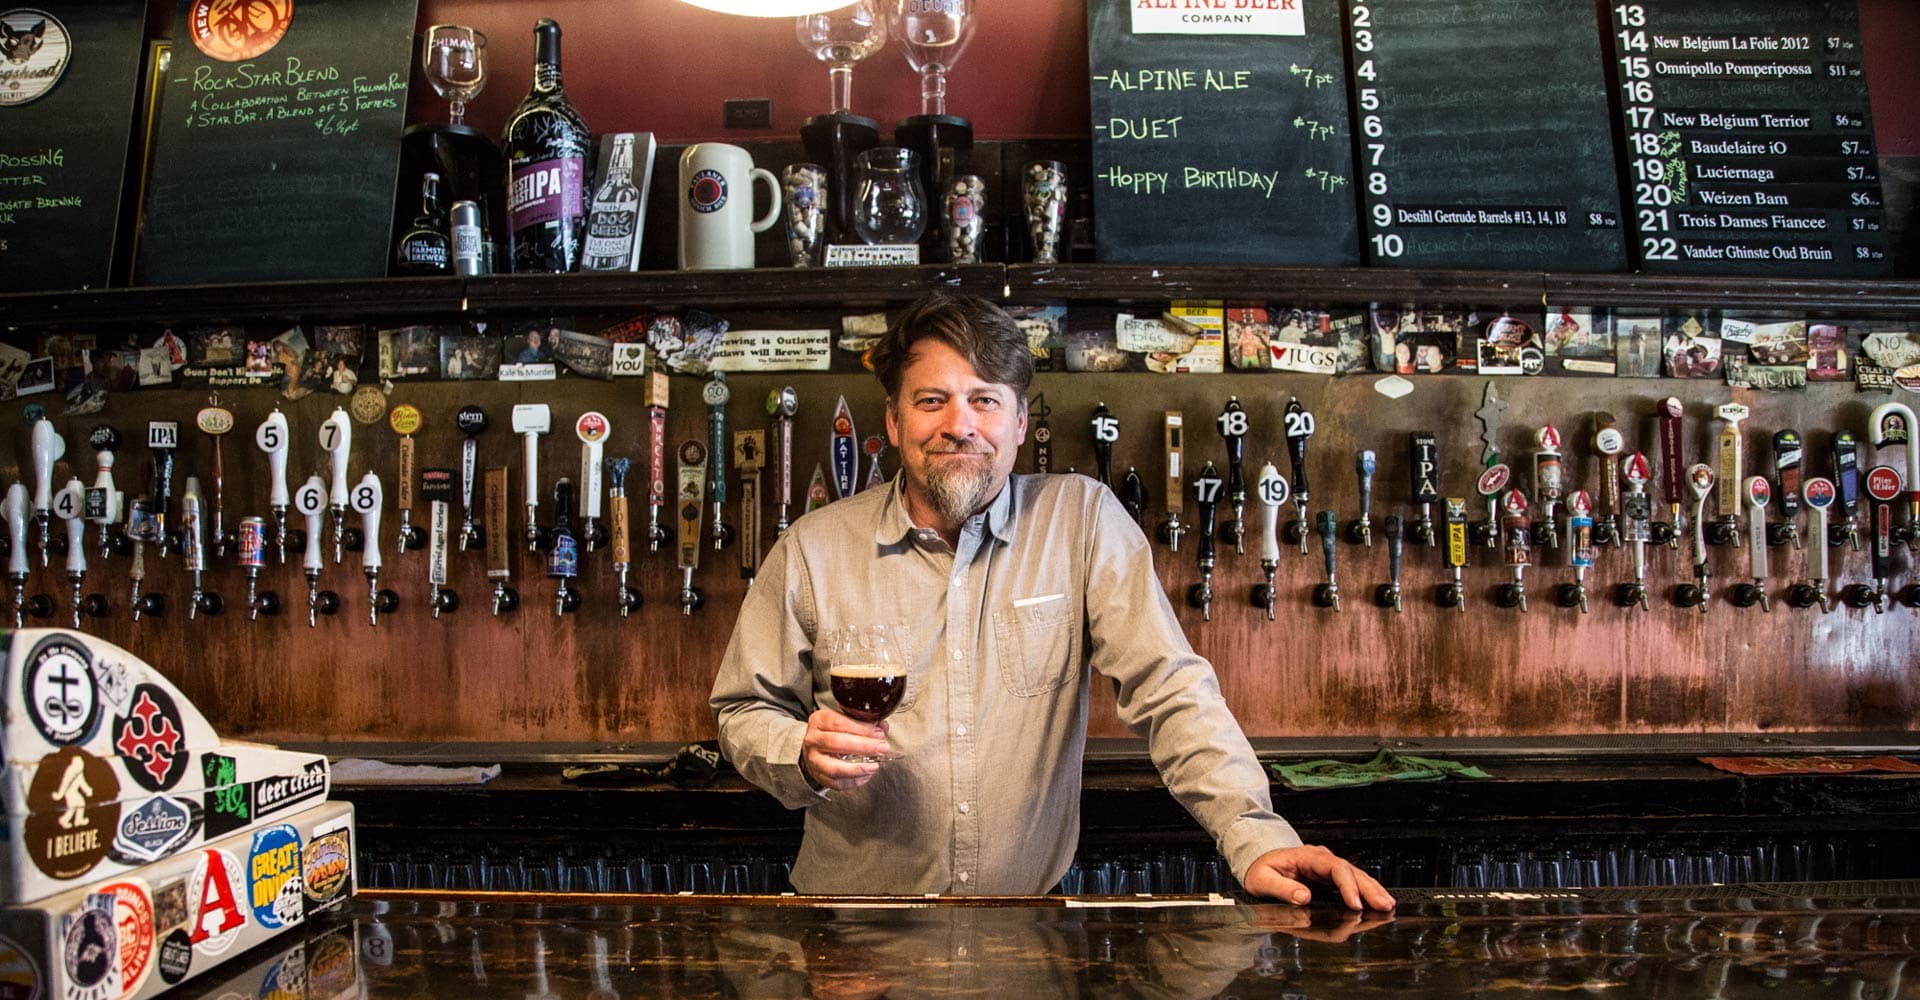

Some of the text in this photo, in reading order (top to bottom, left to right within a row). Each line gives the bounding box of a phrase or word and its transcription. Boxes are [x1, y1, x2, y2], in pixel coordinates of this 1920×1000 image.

[197, 4, 211, 38] NEW
[1182, 15, 1253, 23] COMPANY
[1352, 6, 1371, 27] 2
[1615, 5, 1646, 26] 13
[431, 37, 475, 50] CHIMAY
[1355, 31, 1374, 51] 3
[1618, 30, 1840, 53] 14 New Belgium La Folie 2012 $7
[285, 57, 339, 86] BLEND
[1357, 60, 1376, 81] 4
[1620, 56, 1846, 78] 15 Omnipollo Pomperipossa $11
[1204, 69, 1251, 91] ALE
[202, 94, 287, 111] COLLABORATION
[297, 87, 349, 102] BETWEEN
[1360, 89, 1379, 110] 5
[1623, 81, 1654, 103] 16
[198, 112, 231, 127] STAR
[266, 108, 273, 120] A
[278, 106, 314, 120] BLEND
[319, 103, 335, 113] OF
[339, 99, 349, 112] 5
[1626, 107, 1848, 130] 17 New Belgium Terrior $6
[1363, 116, 1383, 137] 6
[1367, 144, 1385, 166] 7
[1630, 133, 1661, 155] 18
[1691, 140, 1765, 154] Baudelaire
[1841, 141, 1858, 154] $7
[1633, 159, 1864, 181] 19 Luciernaga $7
[529, 168, 561, 202] IPA
[1369, 173, 1387, 195] 8
[36, 195, 82, 209] BREWING
[1636, 184, 1870, 207] 20 Weizen Bam $6
[597, 212, 629, 225] DOS
[1373, 204, 1602, 227] 9 Destihl Gertrude Barrels #13, 14, 18 $8
[1639, 209, 1864, 231] 21 Trois Dames Fiancee $7
[591, 223, 630, 237] BEERS
[1371, 234, 1404, 257] 10
[1642, 238, 1869, 260] 22 Vander Ghinste Oud Bruin $8
[1186, 308, 1208, 316] BEER
[720, 336, 828, 346] rewing is Outlawed
[1876, 335, 1901, 351] NO
[712, 347, 828, 358] utlaws will Brew Beer
[1287, 350, 1336, 368] JUGS
[184, 367, 233, 376] Guns Don't
[500, 367, 554, 377] Kale Murder
[615, 361, 641, 371] YOU
[1860, 374, 1893, 386] BEER
[459, 411, 483, 422] stem
[1218, 411, 1248, 436] 18
[1285, 412, 1314, 437] 20
[151, 428, 176, 443] IPA
[264, 426, 278, 448] 5
[325, 425, 337, 447] 7
[1091, 416, 1120, 442] 15
[653, 424, 663, 478] WHEAT
[839, 437, 849, 490] FAT TIRE
[1419, 445, 1437, 495] IPA
[303, 488, 318, 510] 6
[358, 487, 374, 509] 8
[1195, 478, 1222, 502] 17
[1259, 478, 1286, 501] 19
[59, 493, 73, 514] 4
[437, 504, 446, 528] Series
[435, 530, 445, 550] Aged
[123, 812, 186, 835] Session
[47, 830, 102, 858] I BELIEVE.
[252, 842, 294, 881] GREAT
[123, 935, 150, 982] ALIKE
